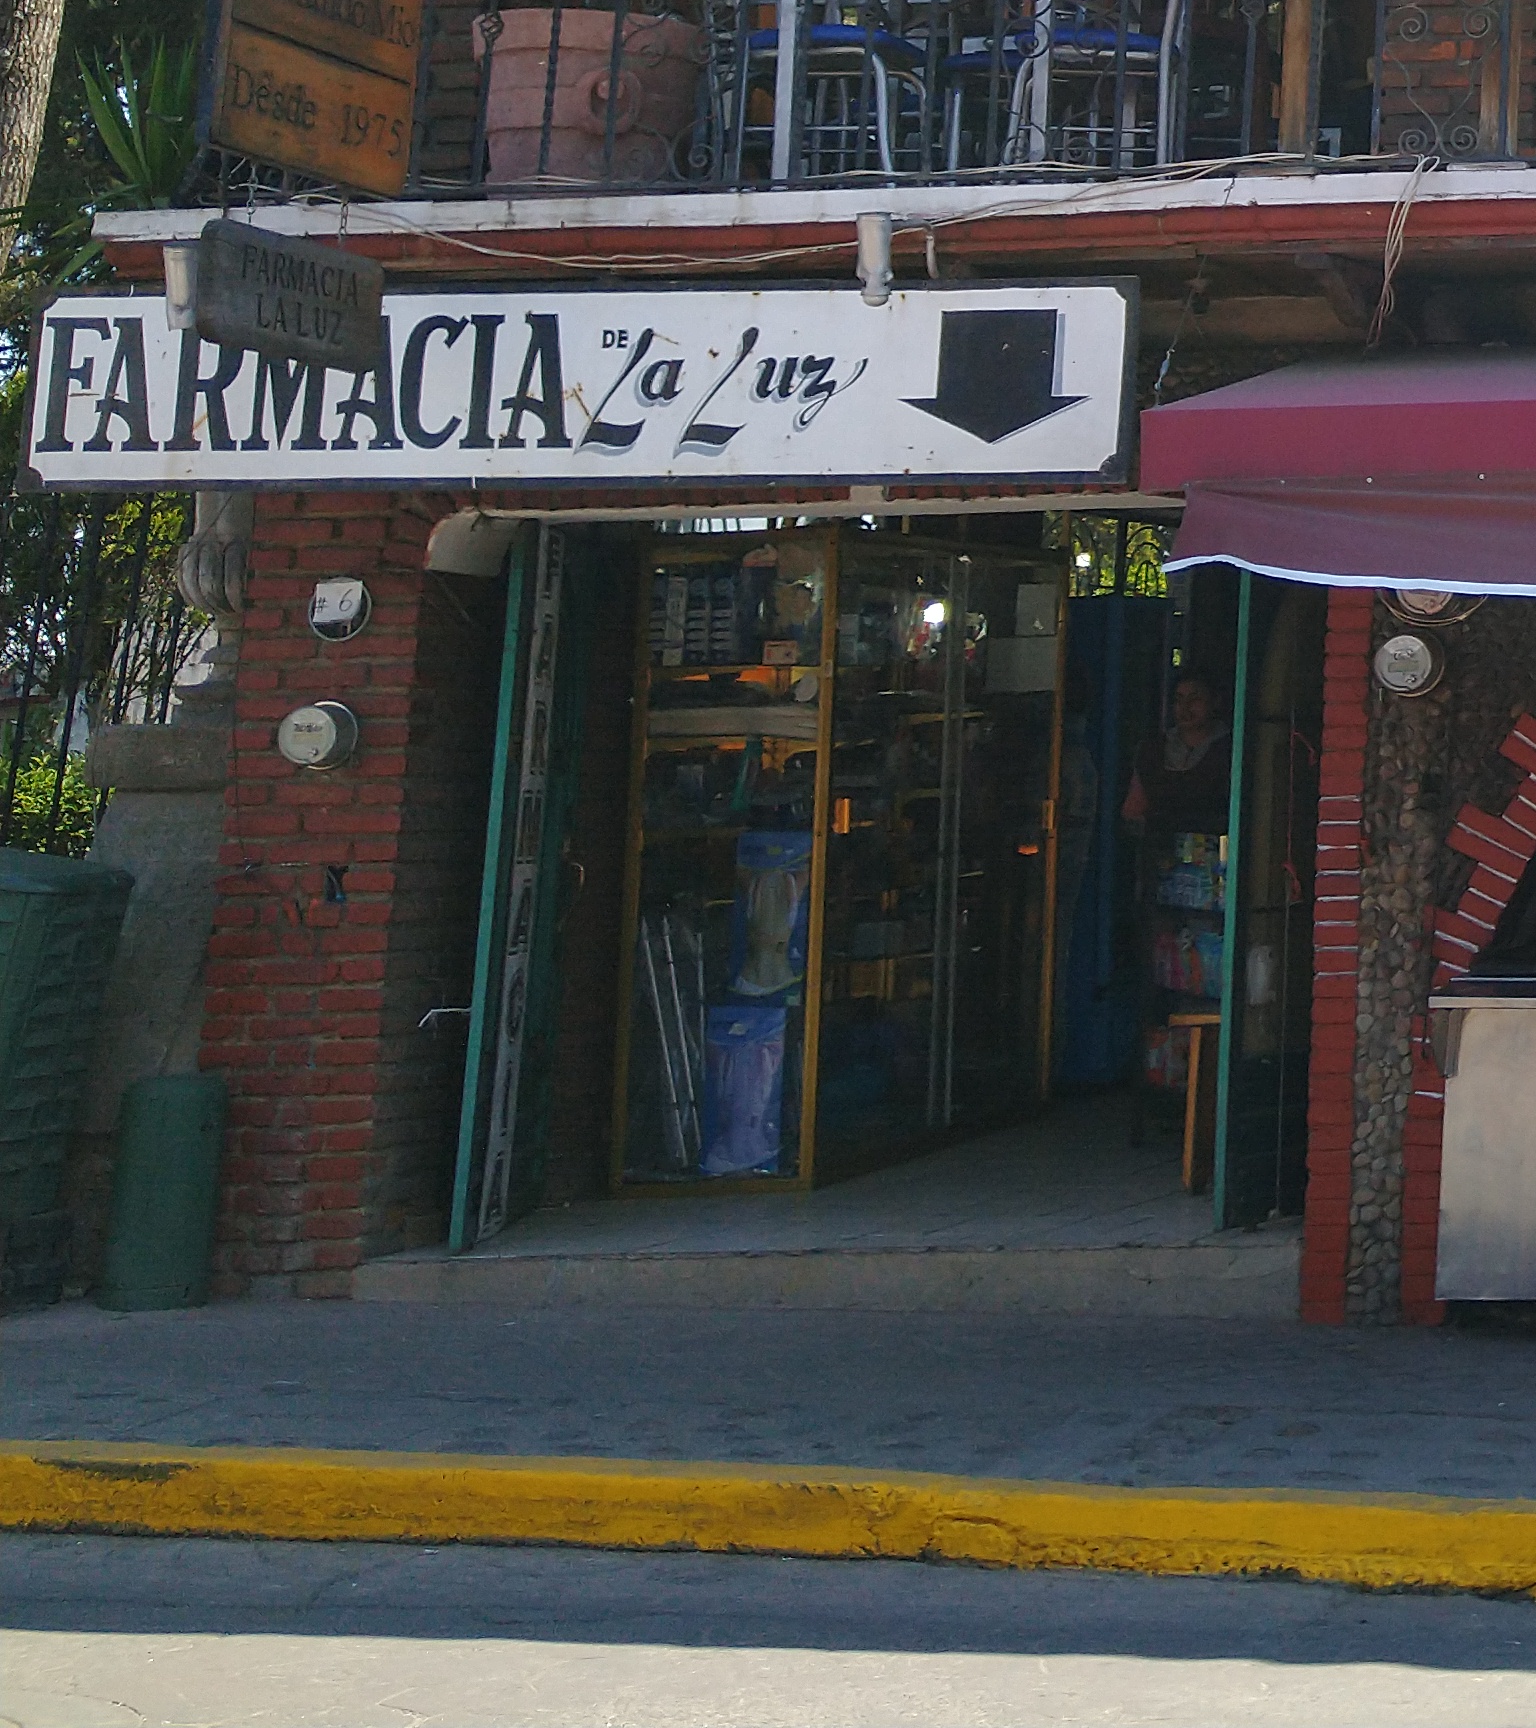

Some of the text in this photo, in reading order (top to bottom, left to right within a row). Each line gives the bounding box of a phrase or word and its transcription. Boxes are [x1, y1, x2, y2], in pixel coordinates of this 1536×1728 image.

[232, 63, 403, 157] Desde 1975
[243, 244, 357, 305] FARMACIA
[255, 294, 342, 344] LA LUZ
[35, 312, 868, 457] FARMACIA DE La Luz
[339, 588, 353, 612] 6
